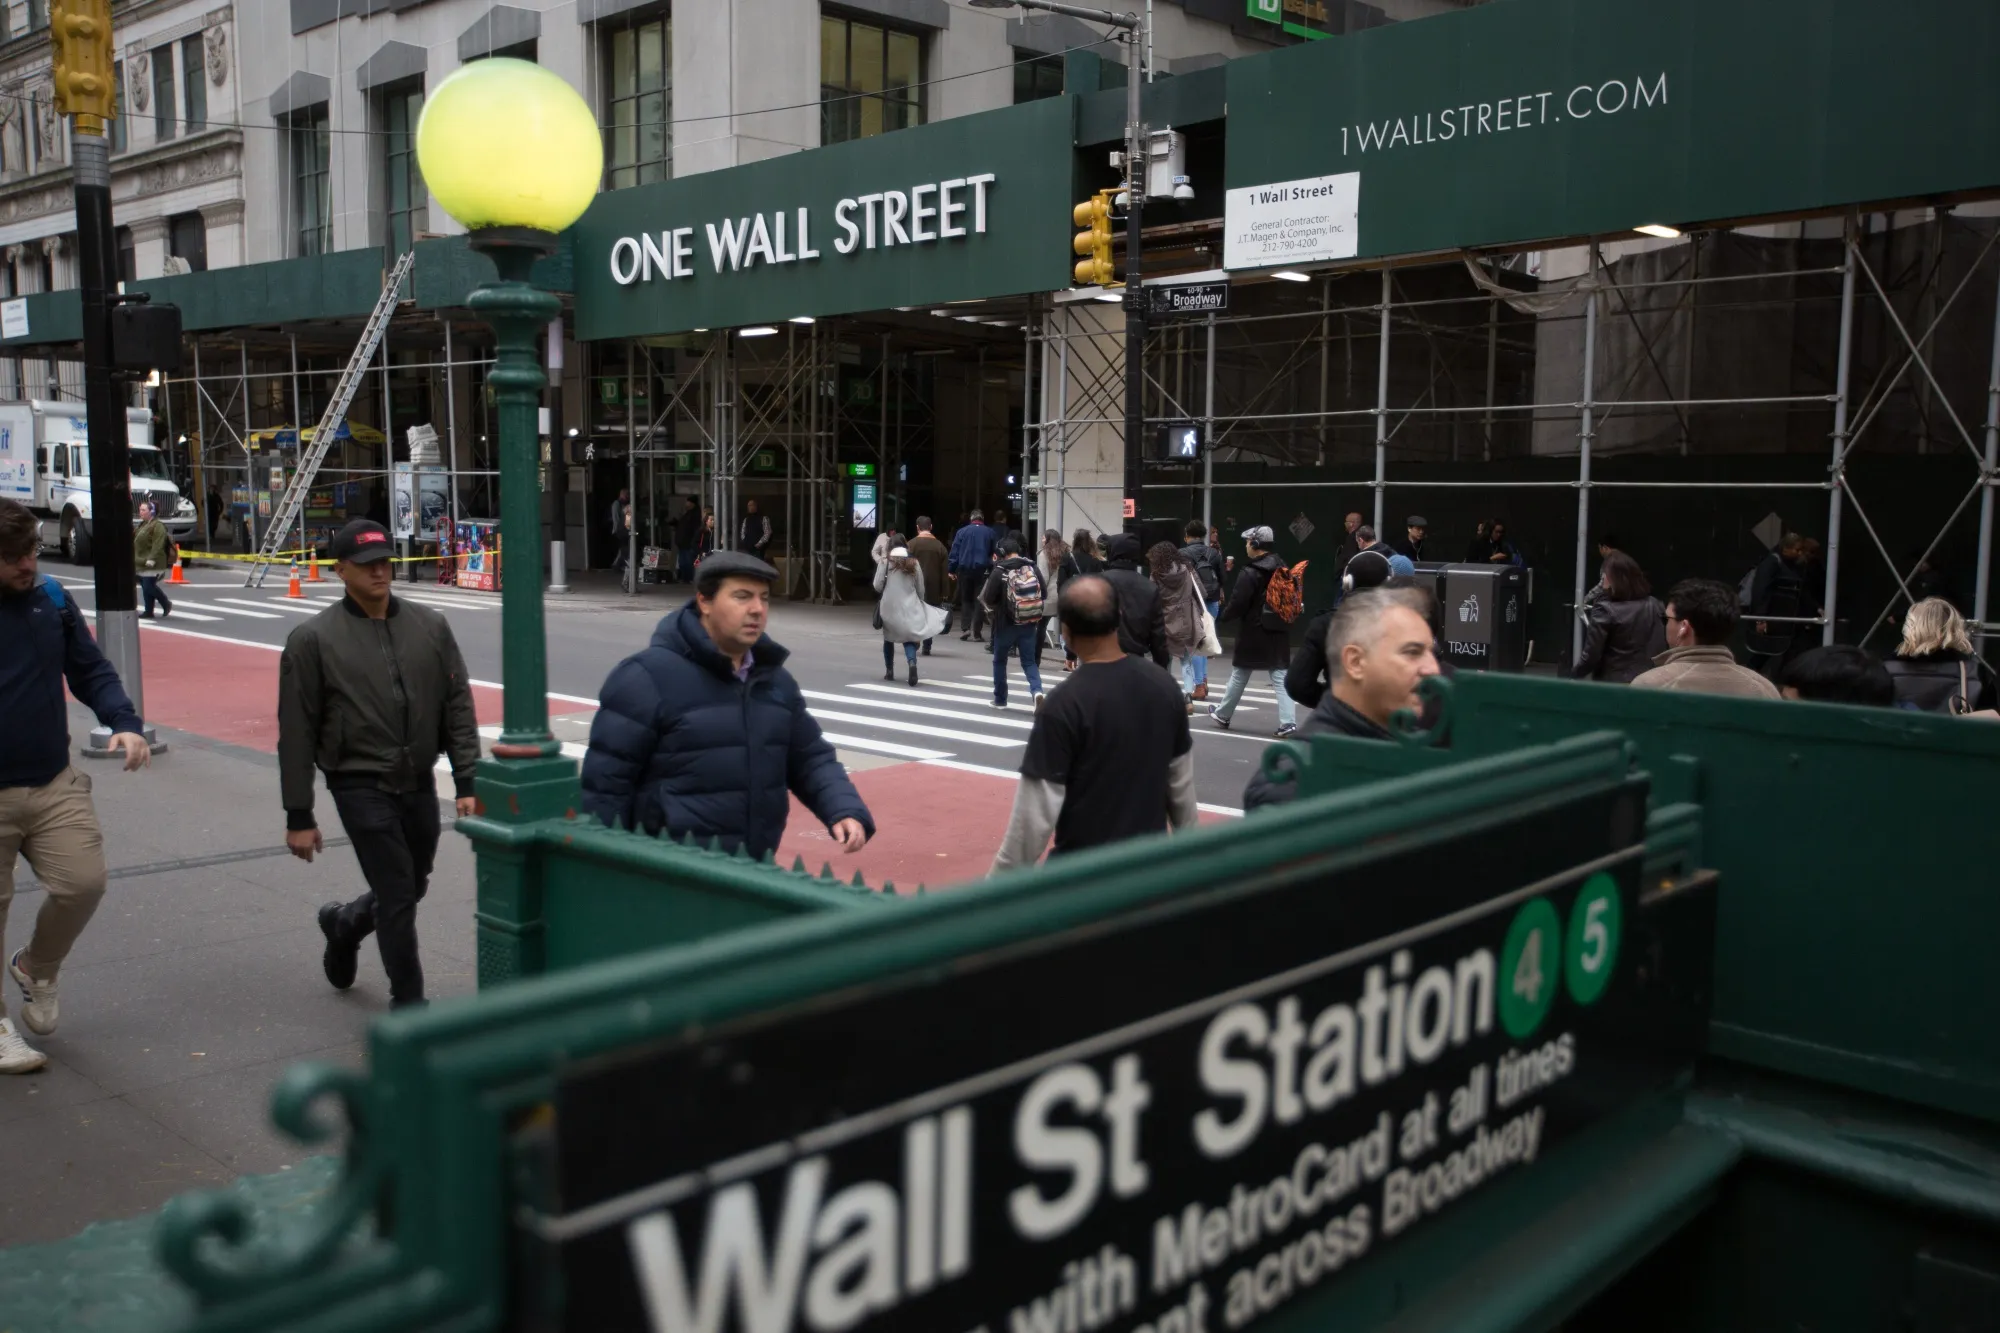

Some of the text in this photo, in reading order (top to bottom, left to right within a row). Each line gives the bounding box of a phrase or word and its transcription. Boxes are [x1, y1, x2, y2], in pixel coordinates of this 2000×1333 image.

[1341, 71, 1667, 156] 1WALLSTREET.COM
[1249, 184, 1334, 206] 1 Wall Street
[609, 172, 995, 286] ONE WALL STREET
[1251, 215, 1330, 231] General Contractor:
[1250, 231, 1278, 243] Magen
[1279, 230, 1286, 239] &
[1287, 227, 1328, 240] Company,
[1329, 224, 1344, 234] Inc.
[1262, 238, 1318, 252] 212-790-4200
[1173, 293, 1222, 307] Broadway
[603, 382, 617, 398] TD
[678, 453, 690, 467] TD
[758, 453, 773, 467] TD
[1448, 640, 1486, 656] TRASH
[628, 897, 1609, 1333] Wall St Station 4 5
[1152, 1111, 1391, 1293] MetroCard
[1399, 1090, 1440, 1159] at
[1448, 1062, 1488, 1134] all
[1495, 1031, 1575, 1107] times
[1224, 1203, 1371, 1326] across
[1381, 1105, 1545, 1236] Broadway
